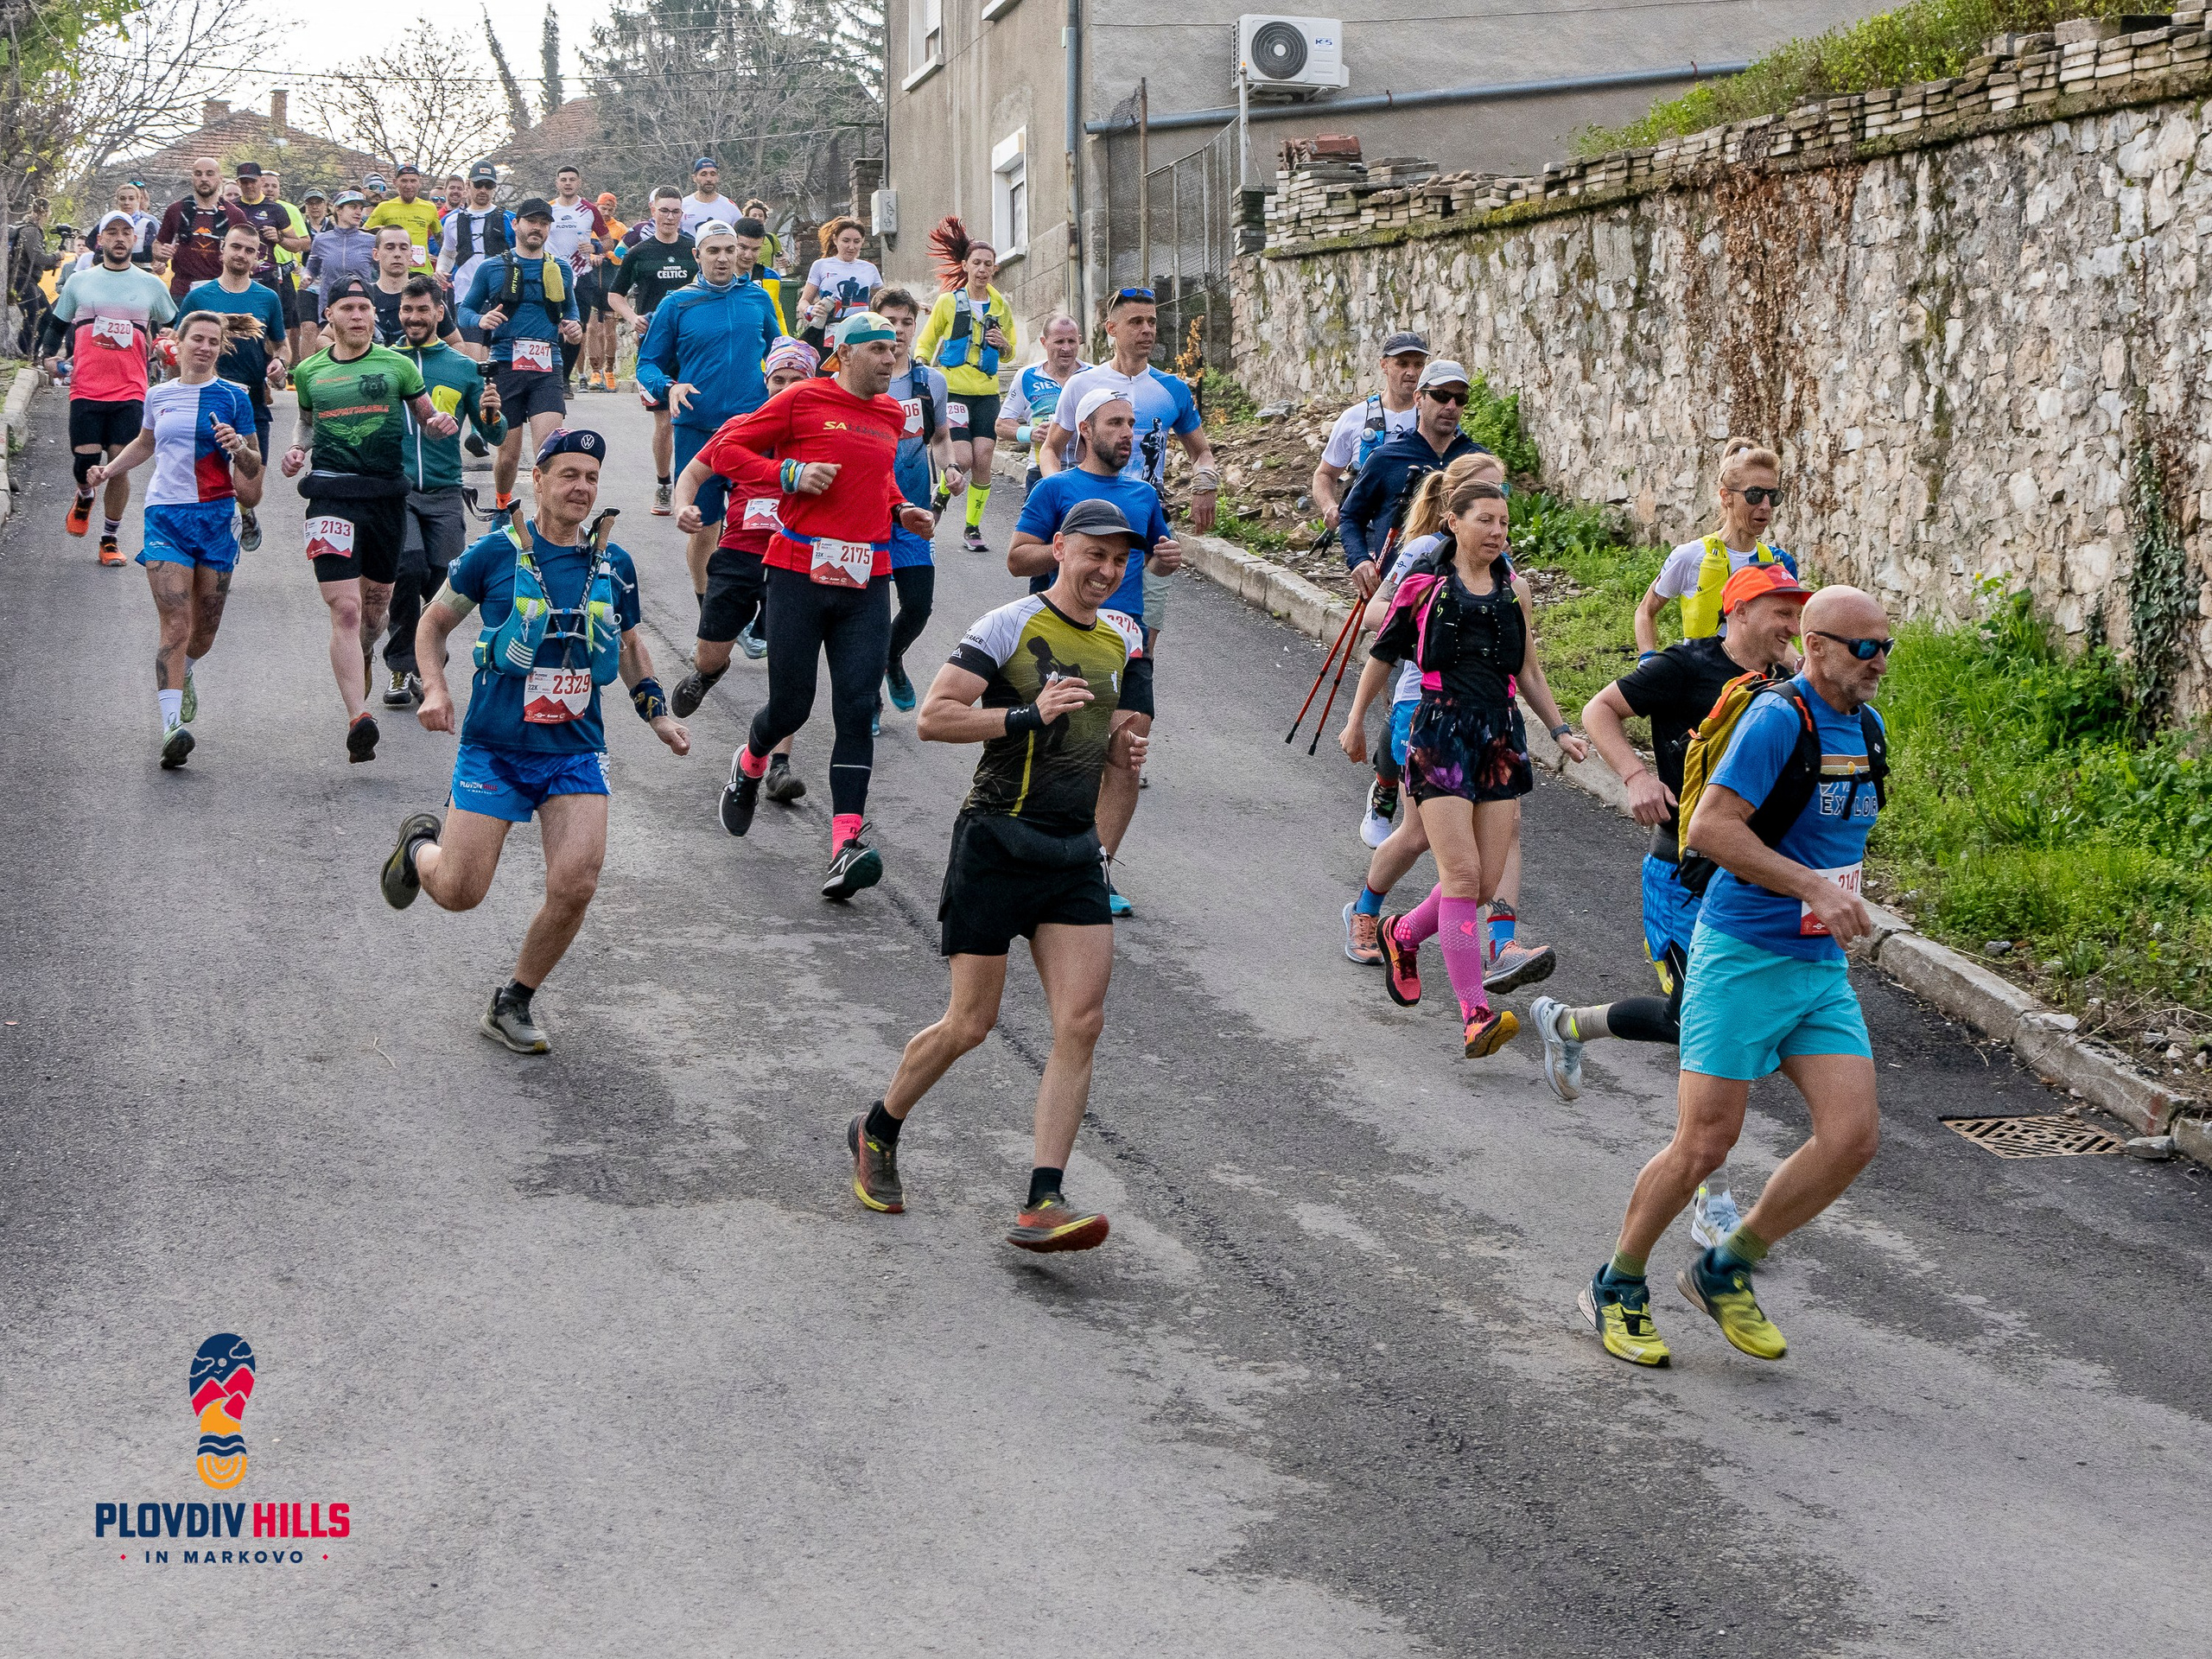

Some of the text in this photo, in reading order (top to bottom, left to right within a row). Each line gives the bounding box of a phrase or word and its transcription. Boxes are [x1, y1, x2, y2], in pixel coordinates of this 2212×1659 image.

[657, 270, 688, 279] CELTICS
[107, 321, 131, 335] 2320
[529, 344, 550, 357] 2247
[320, 520, 352, 537] 2133
[840, 545, 870, 565] 2175
[552, 674, 591, 695] 2329
[1820, 795, 1878, 817] EXLOR
